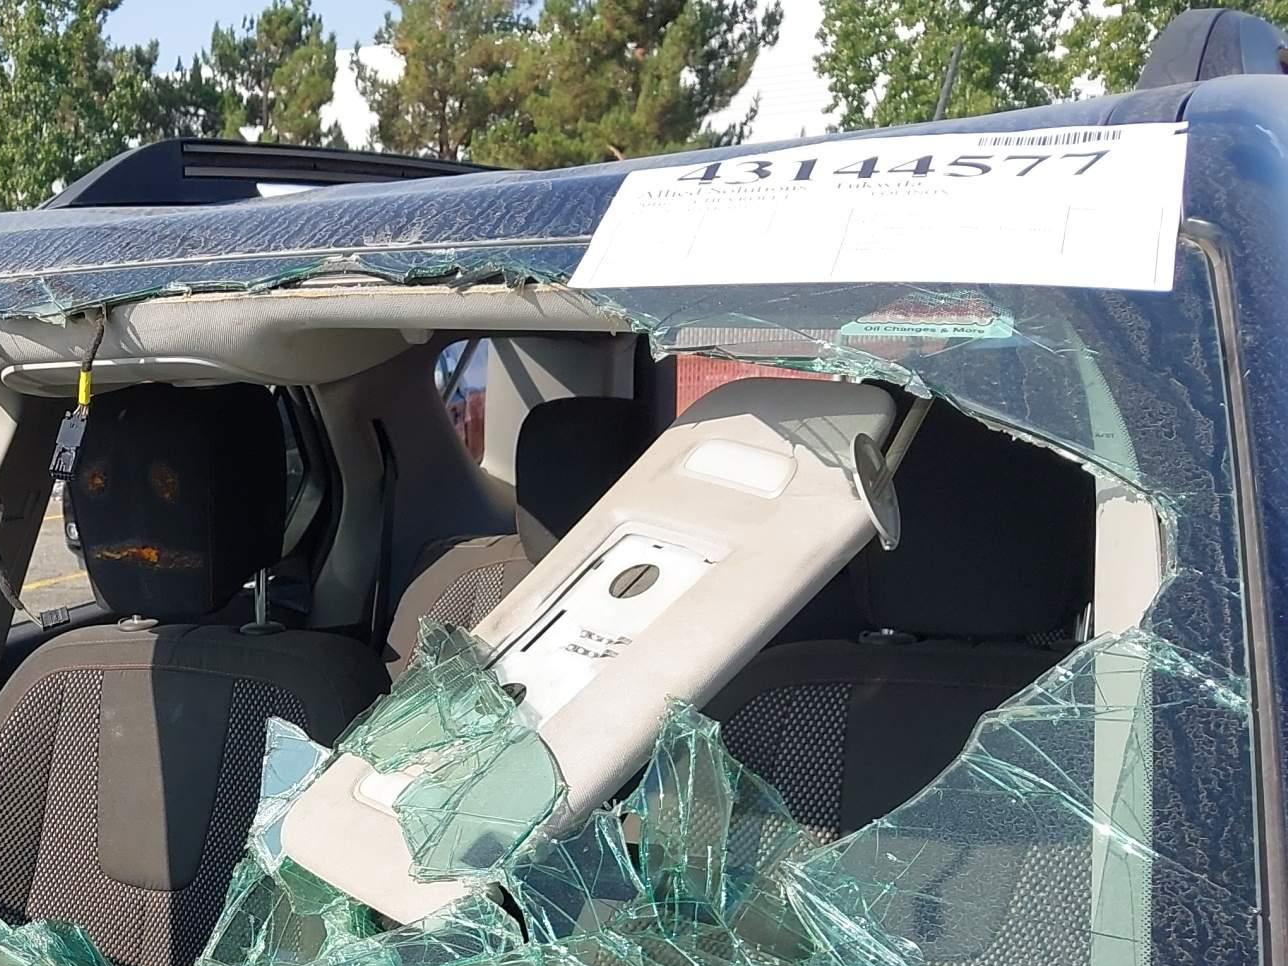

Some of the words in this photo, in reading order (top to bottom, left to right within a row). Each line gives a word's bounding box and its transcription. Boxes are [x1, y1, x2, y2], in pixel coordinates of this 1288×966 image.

[677, 149, 1111, 185] 43144577
[883, 325, 937, 333] Changes
[952, 326, 986, 334] More
